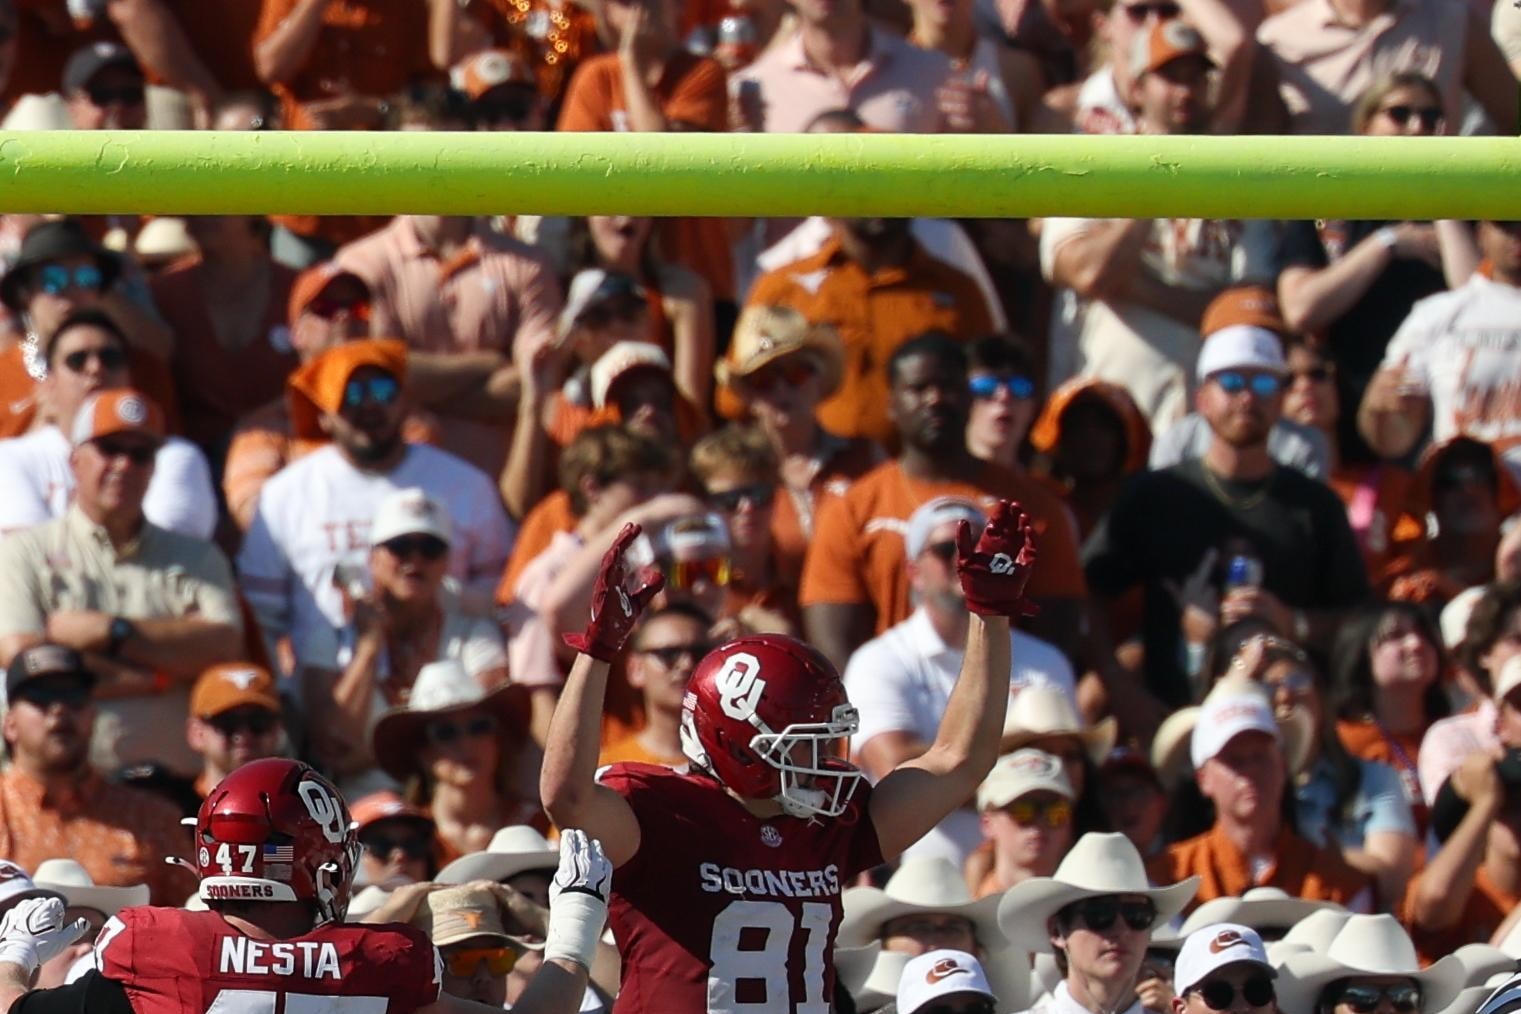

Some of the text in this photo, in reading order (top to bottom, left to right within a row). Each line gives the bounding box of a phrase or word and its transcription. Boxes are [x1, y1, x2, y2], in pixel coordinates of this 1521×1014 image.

[715, 652, 767, 721] OU
[298, 780, 345, 843] OU
[215, 843, 257, 875] 47
[207, 884, 274, 898] SOONERS
[699, 862, 840, 897] SOONERS
[220, 936, 342, 980] NESTA
